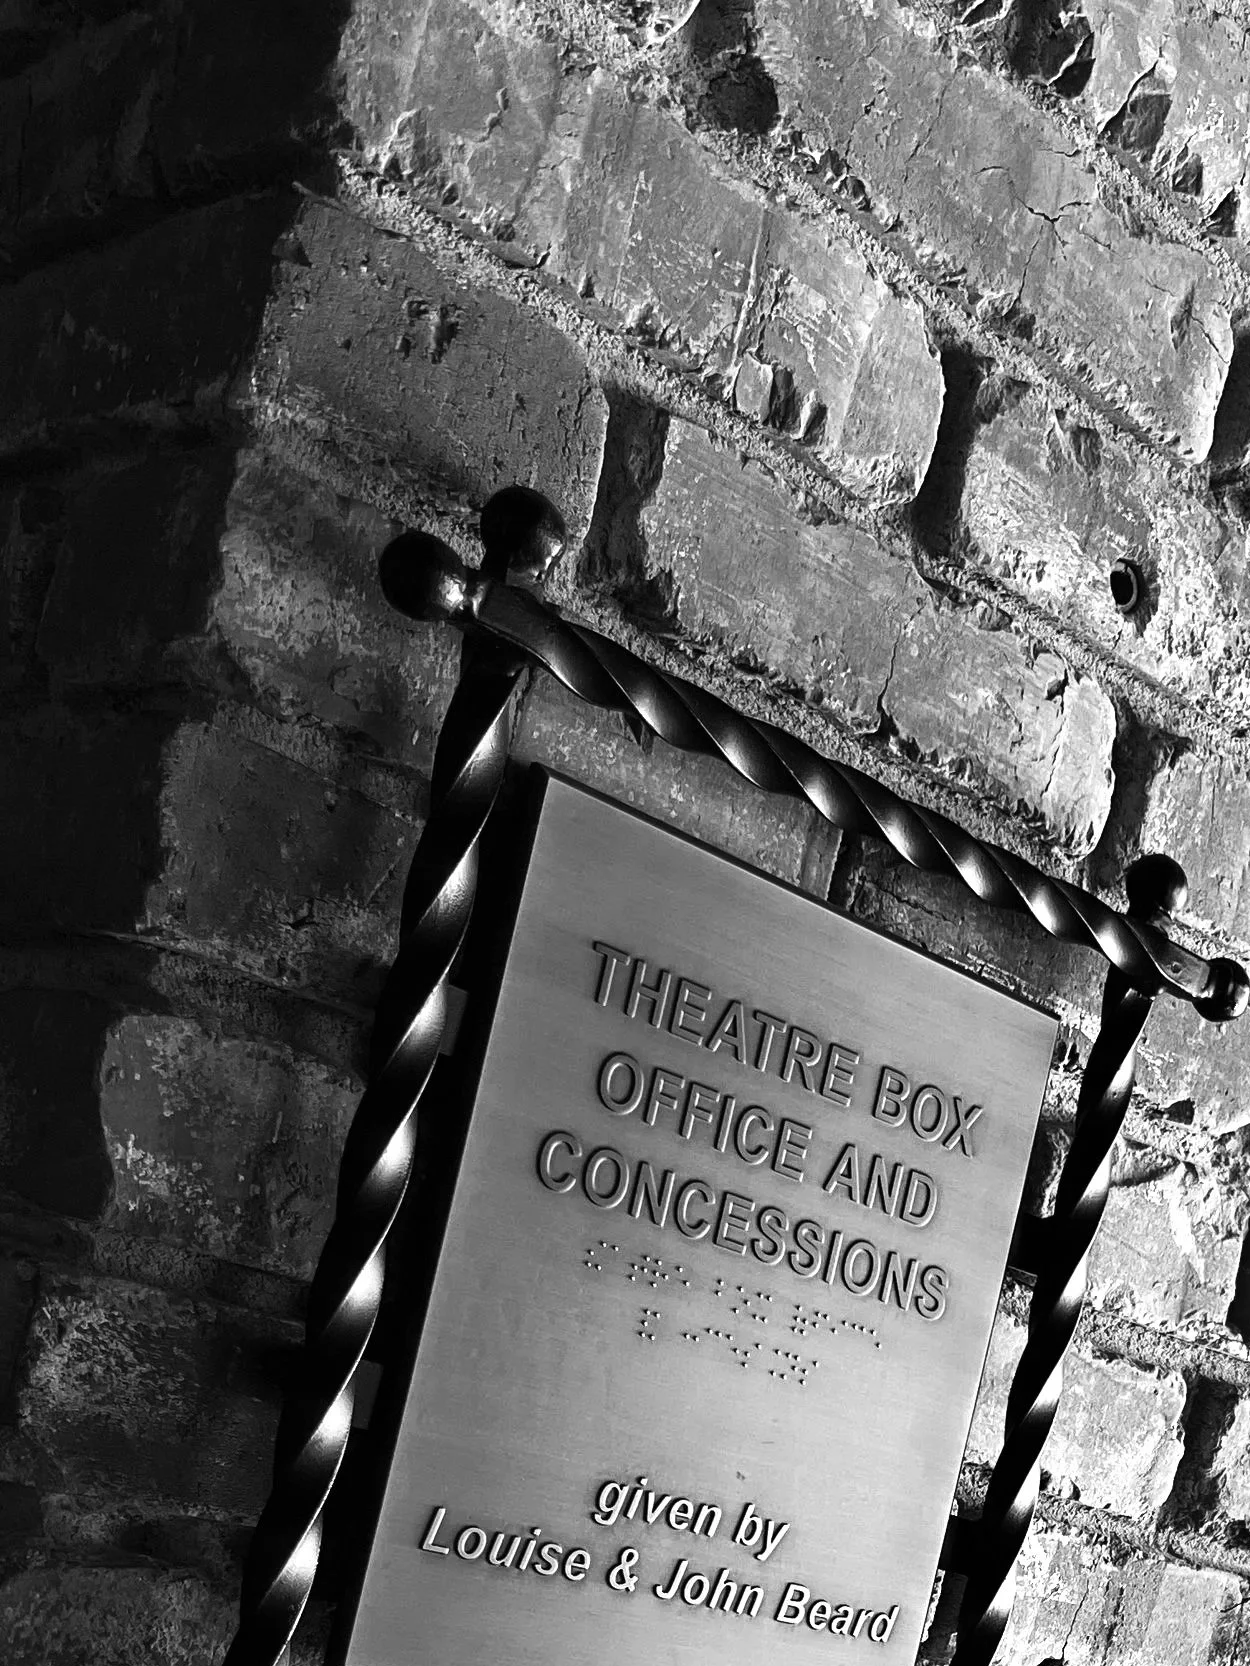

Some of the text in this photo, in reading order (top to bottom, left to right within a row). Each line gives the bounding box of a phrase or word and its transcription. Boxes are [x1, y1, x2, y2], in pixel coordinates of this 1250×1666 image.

[593, 942, 983, 1157] THEATRE BOX
[537, 1131, 949, 1321] CONCESSIONS
[597, 1052, 938, 1228] OFFICE AND
[420, 1506, 899, 1643] Louise & John Beard
[594, 1477, 790, 1561] given by
